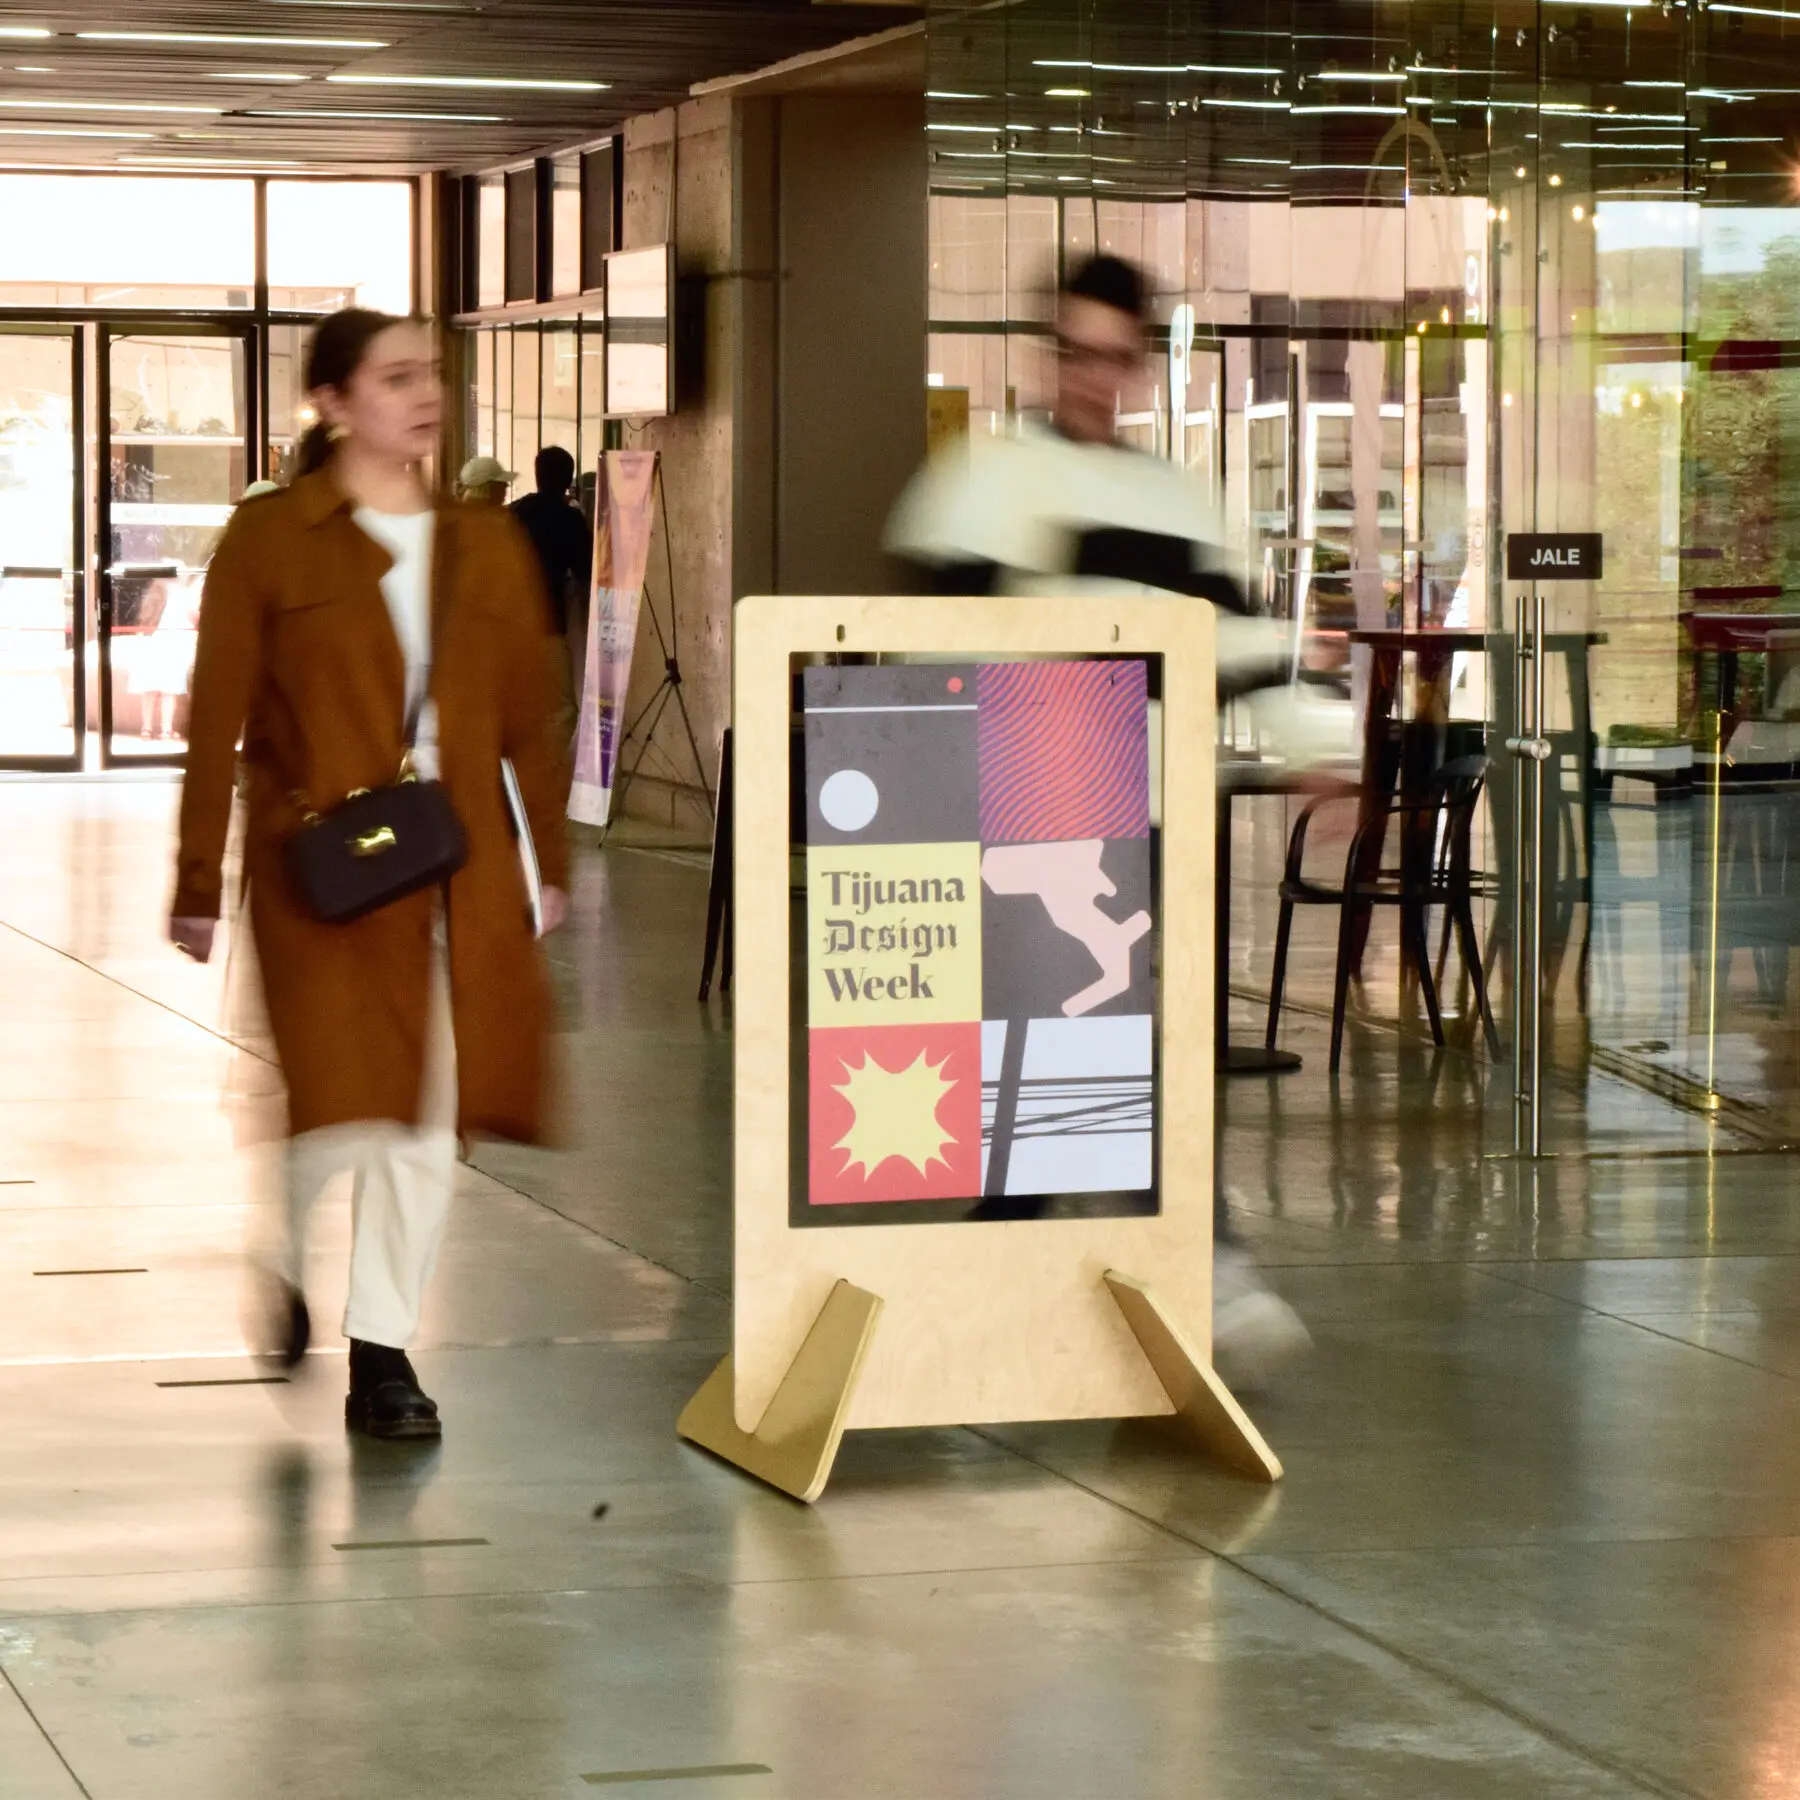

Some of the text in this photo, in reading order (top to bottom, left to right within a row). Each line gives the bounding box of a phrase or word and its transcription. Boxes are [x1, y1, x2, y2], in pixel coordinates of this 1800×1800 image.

[1530, 548, 1580, 566] JALE
[821, 871, 965, 916] Tijuana
[822, 917, 958, 958] Design
[822, 963, 935, 1002] Week
